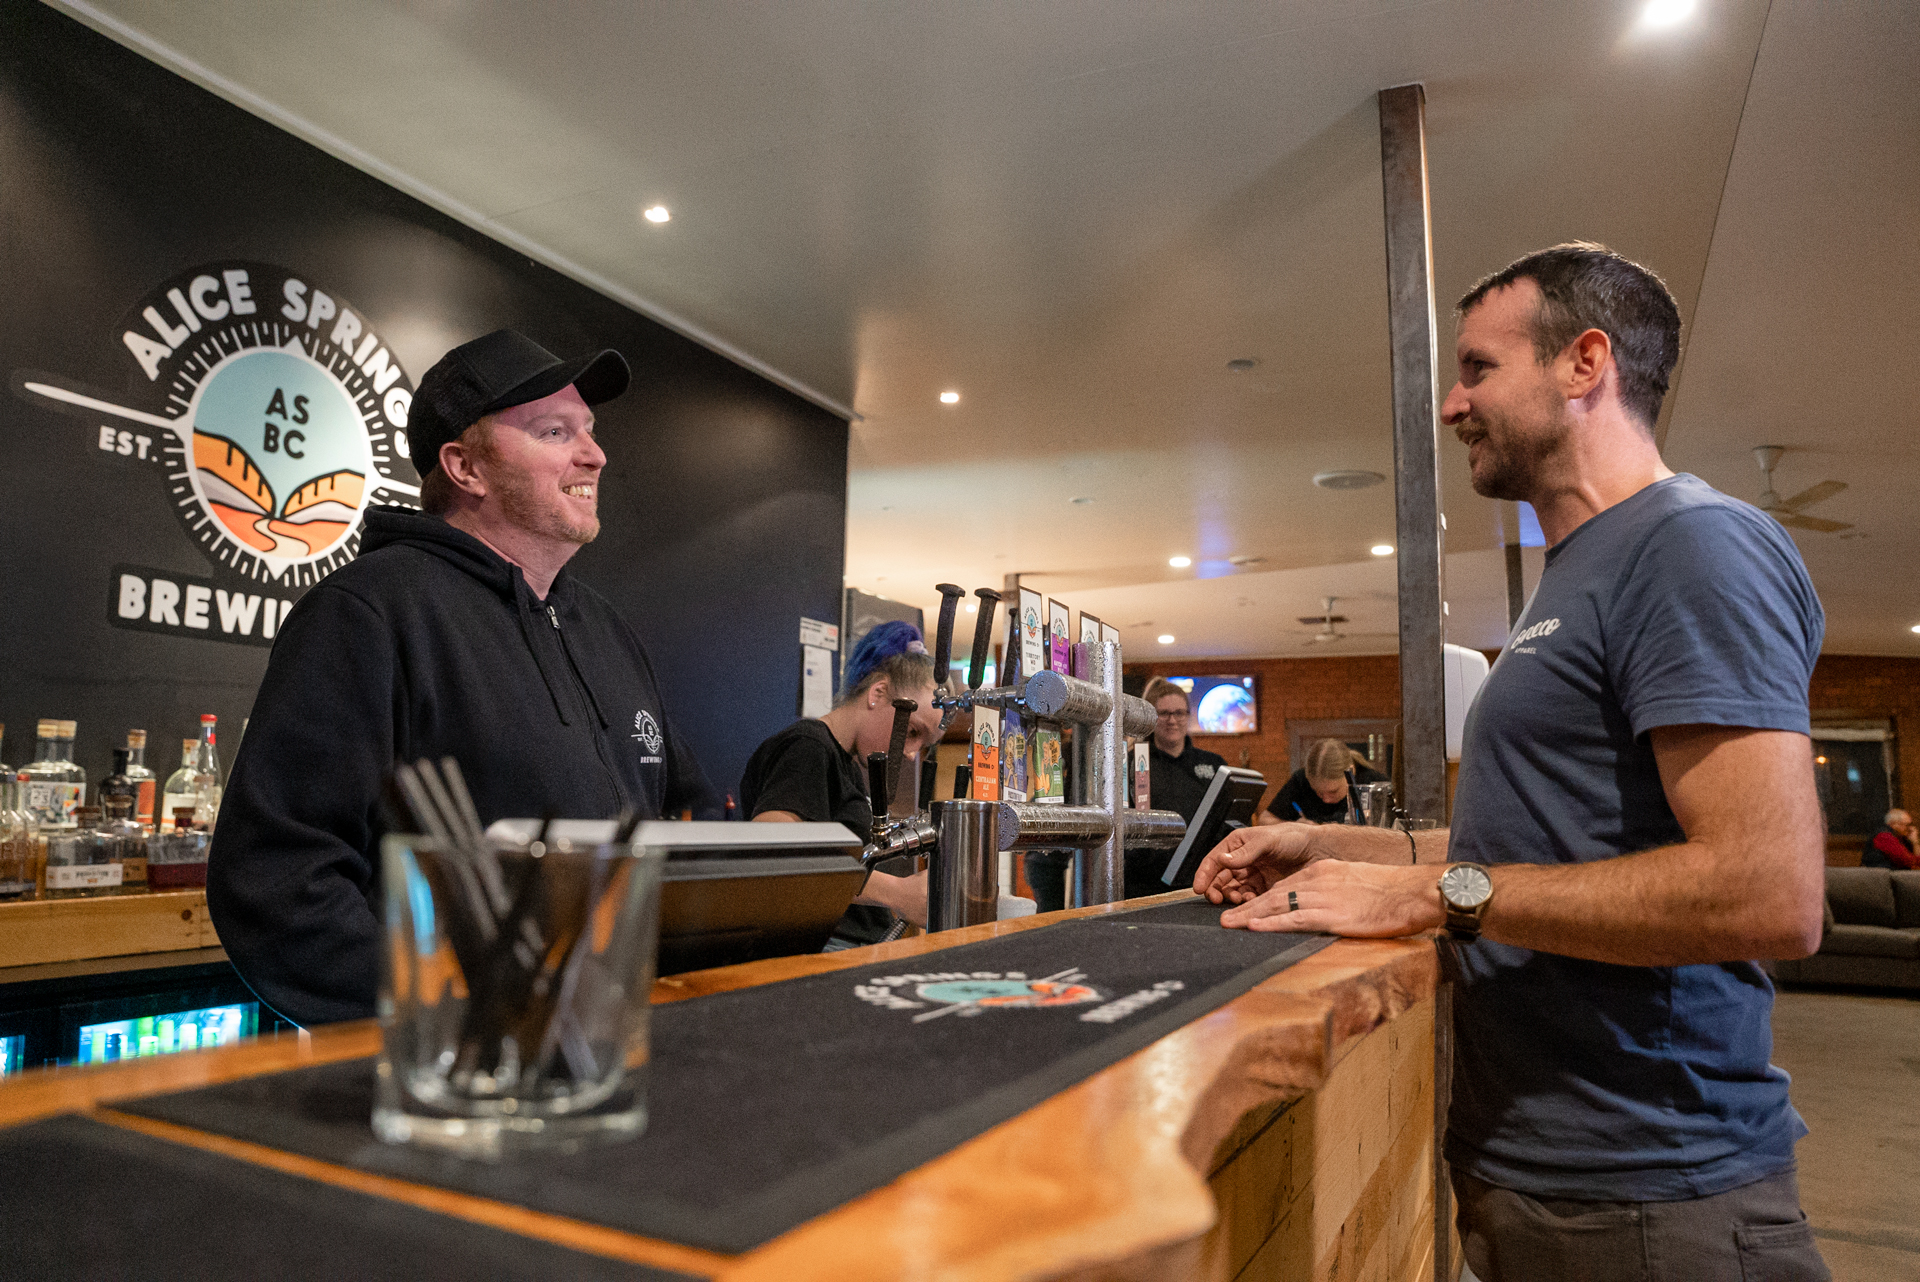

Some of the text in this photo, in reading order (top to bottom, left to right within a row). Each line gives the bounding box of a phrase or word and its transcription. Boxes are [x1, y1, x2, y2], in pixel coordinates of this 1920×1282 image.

[122, 268, 257, 381] ALICE
[265, 387, 310, 425] AS
[98, 425, 158, 462] EST.
[263, 421, 306, 460] BC
[118, 573, 294, 639] BREWI
